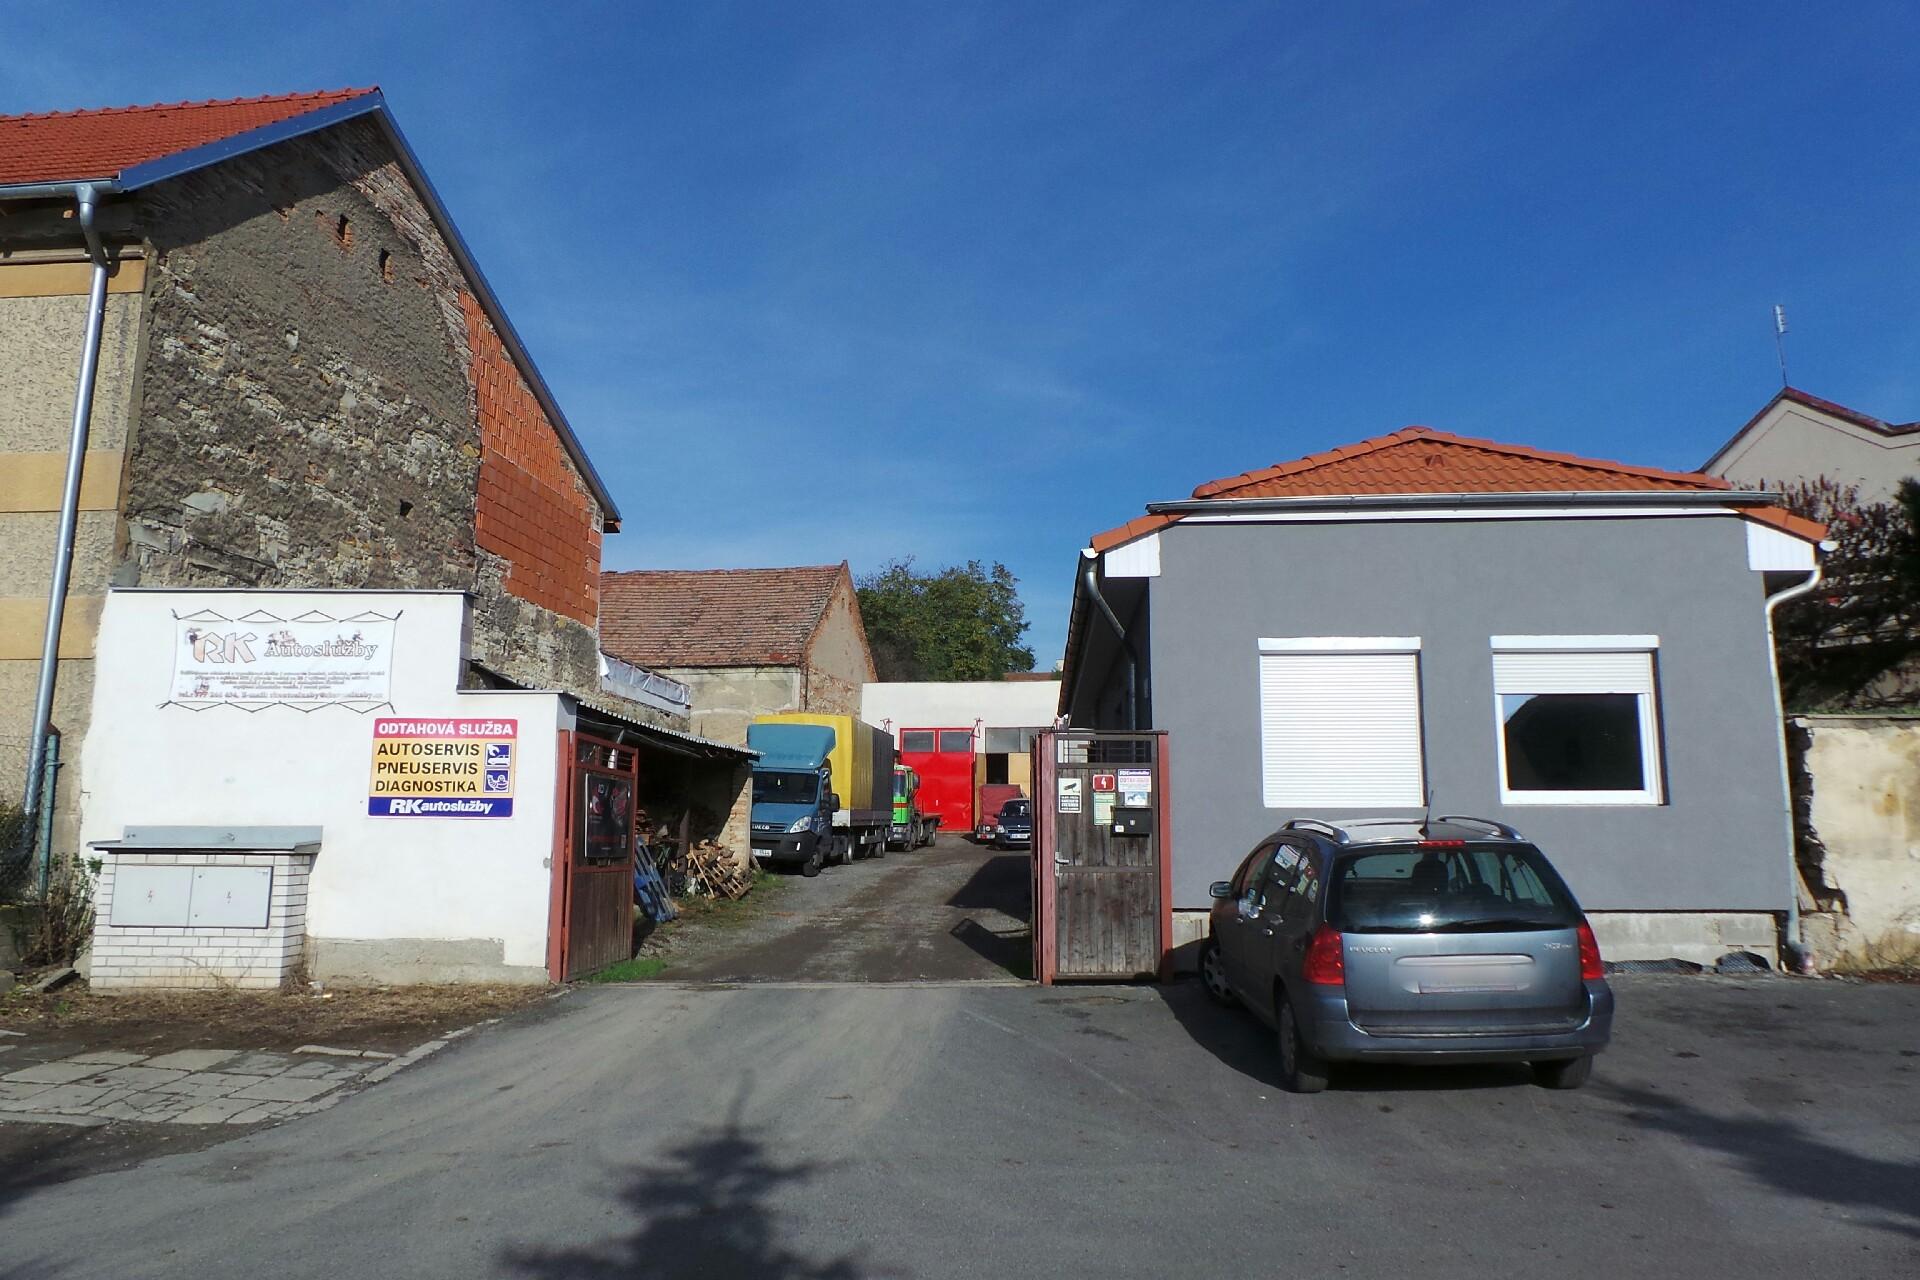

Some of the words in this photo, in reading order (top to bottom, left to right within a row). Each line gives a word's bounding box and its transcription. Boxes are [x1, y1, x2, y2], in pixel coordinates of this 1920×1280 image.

[193, 631, 258, 663] RK
[264, 640, 379, 660] Autoslužby
[379, 720, 455, 735] ODTAHOVÁ
[459, 720, 513, 735] SLUŽBA
[377, 743, 480, 756] AUTOSERVIS
[377, 762, 478, 775] PNEUSERVIS
[375, 780, 477, 793] DIAGNOSTIKA
[1101, 777, 1107, 789] 4
